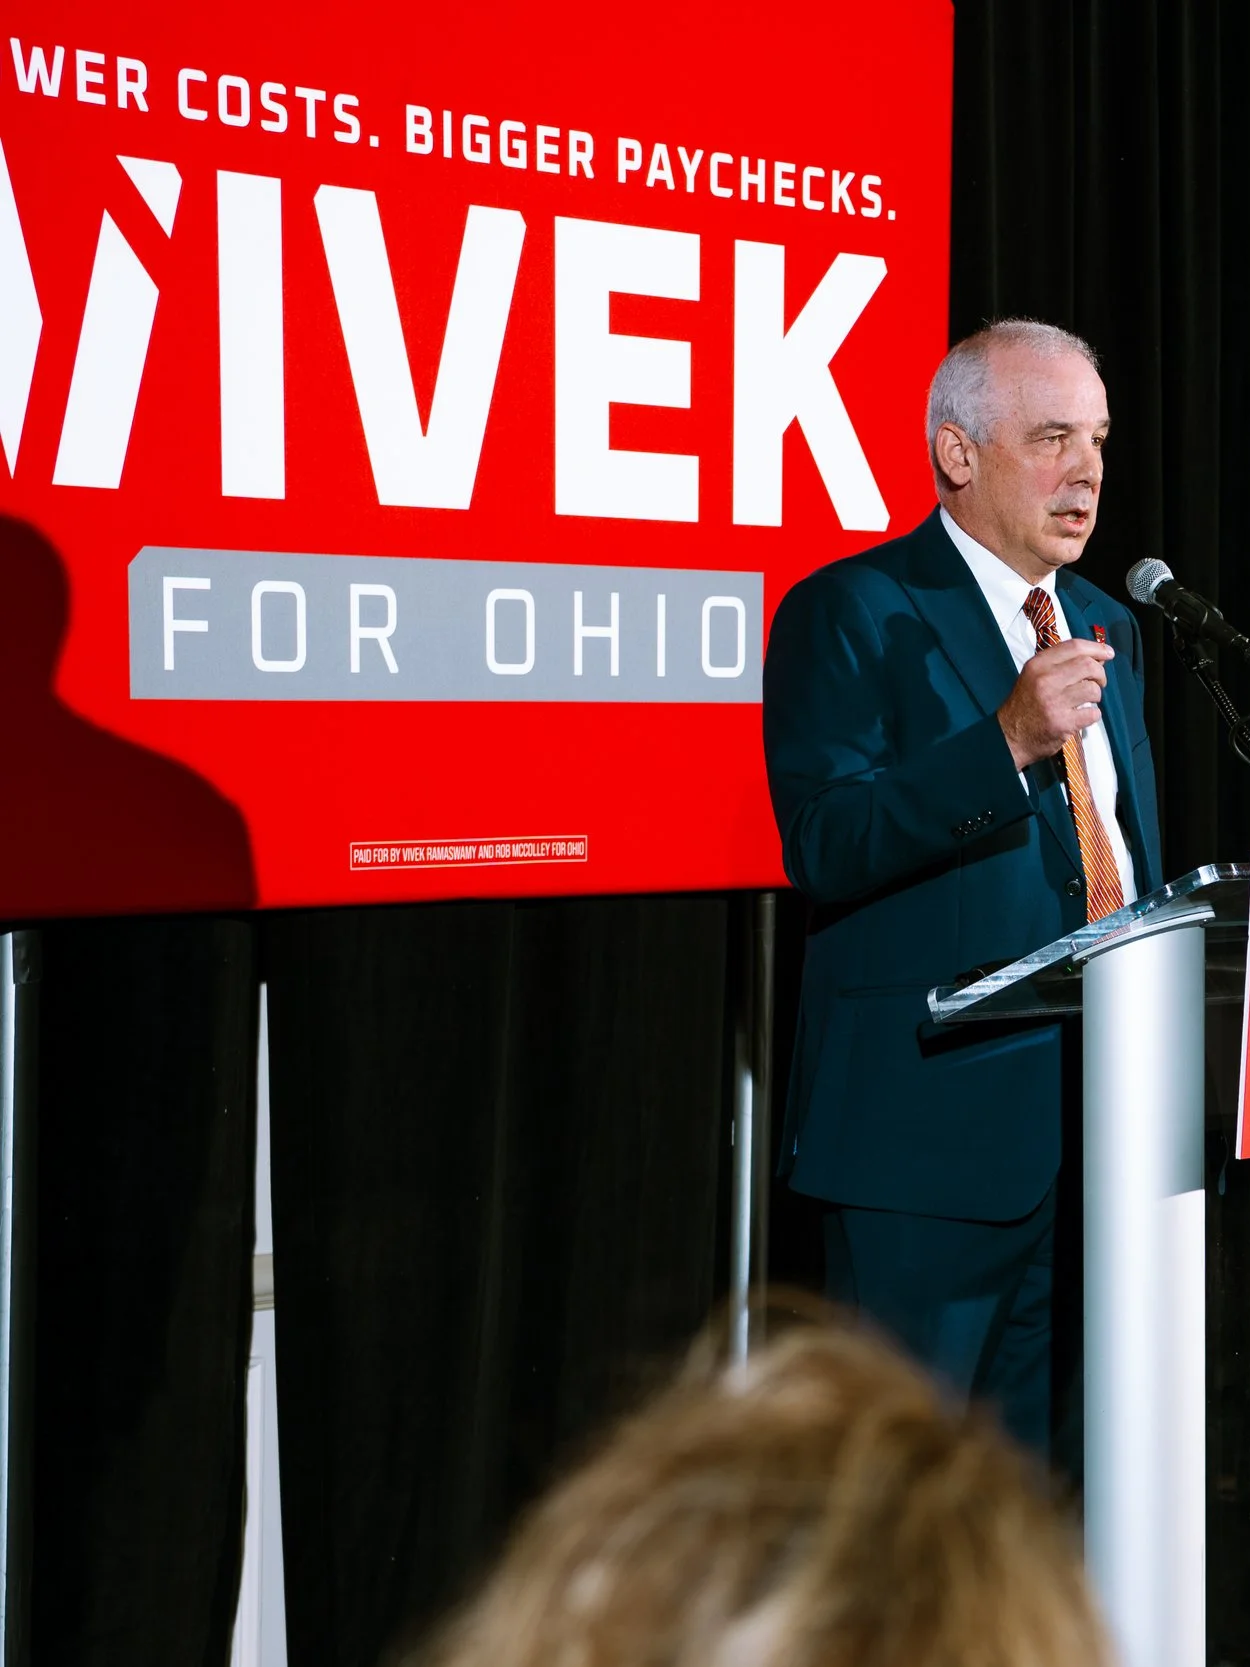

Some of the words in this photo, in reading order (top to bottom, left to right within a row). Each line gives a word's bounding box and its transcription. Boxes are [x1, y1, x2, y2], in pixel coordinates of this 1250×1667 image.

[9, 37, 149, 113] WER
[177, 67, 380, 148] COSTS.
[405, 103, 595, 179] BIGGER
[617, 136, 896, 221] PAYCHECKS.
[162, 575, 400, 675] FOR
[485, 587, 747, 679] OHIO
[353, 848, 372, 863] PAID
[373, 848, 389, 863] FOR
[390, 847, 401, 862] BY
[402, 846, 425, 862] VIVEK
[426, 844, 477, 861] RAMASWAMY
[478, 844, 494, 859] AND
[495, 843, 511, 859] ROB
[512, 842, 550, 857] MCCOLLEY
[551, 841, 566, 856] FOR
[567, 841, 585, 856] OHIO
